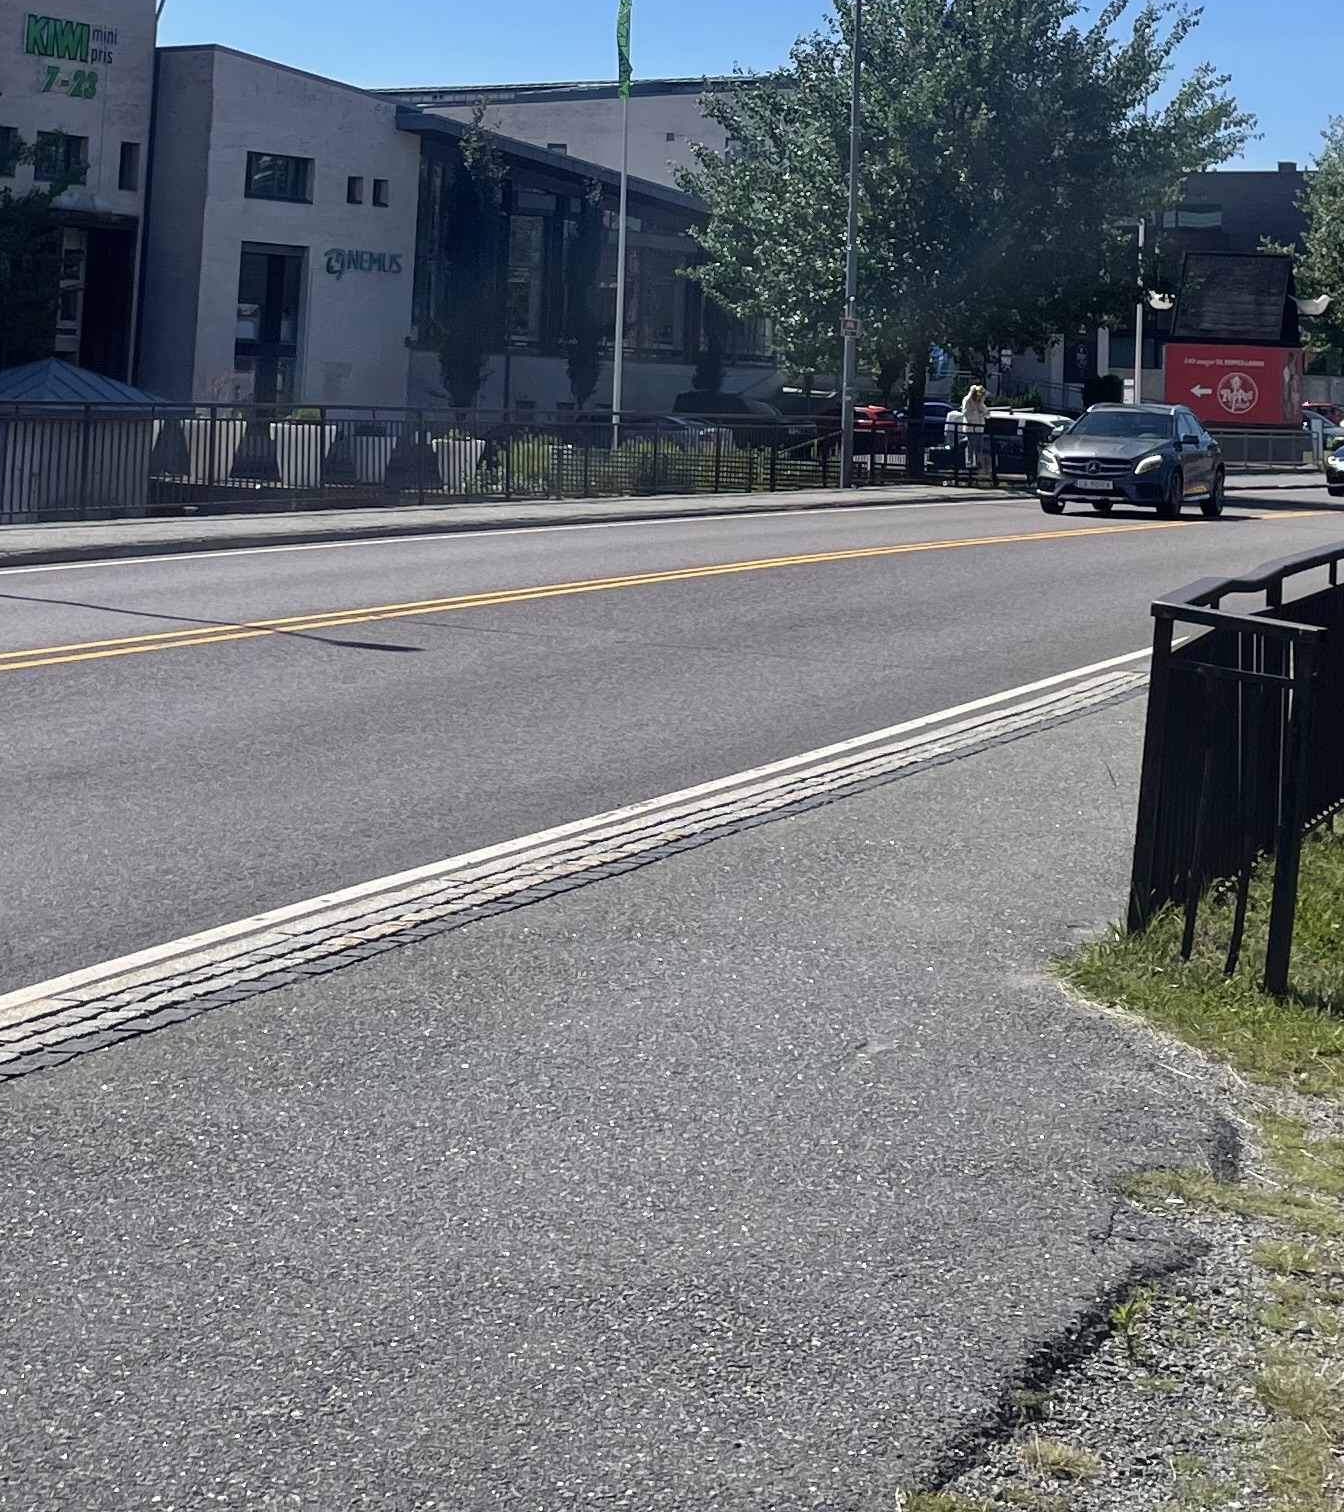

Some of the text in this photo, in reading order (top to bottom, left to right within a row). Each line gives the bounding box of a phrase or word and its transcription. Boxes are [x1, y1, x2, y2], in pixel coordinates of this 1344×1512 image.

[25, 14, 90, 63] KIWI
[92, 25, 119, 45] mini
[90, 45, 114, 65] pris
[347, 249, 403, 274] NEMUS
